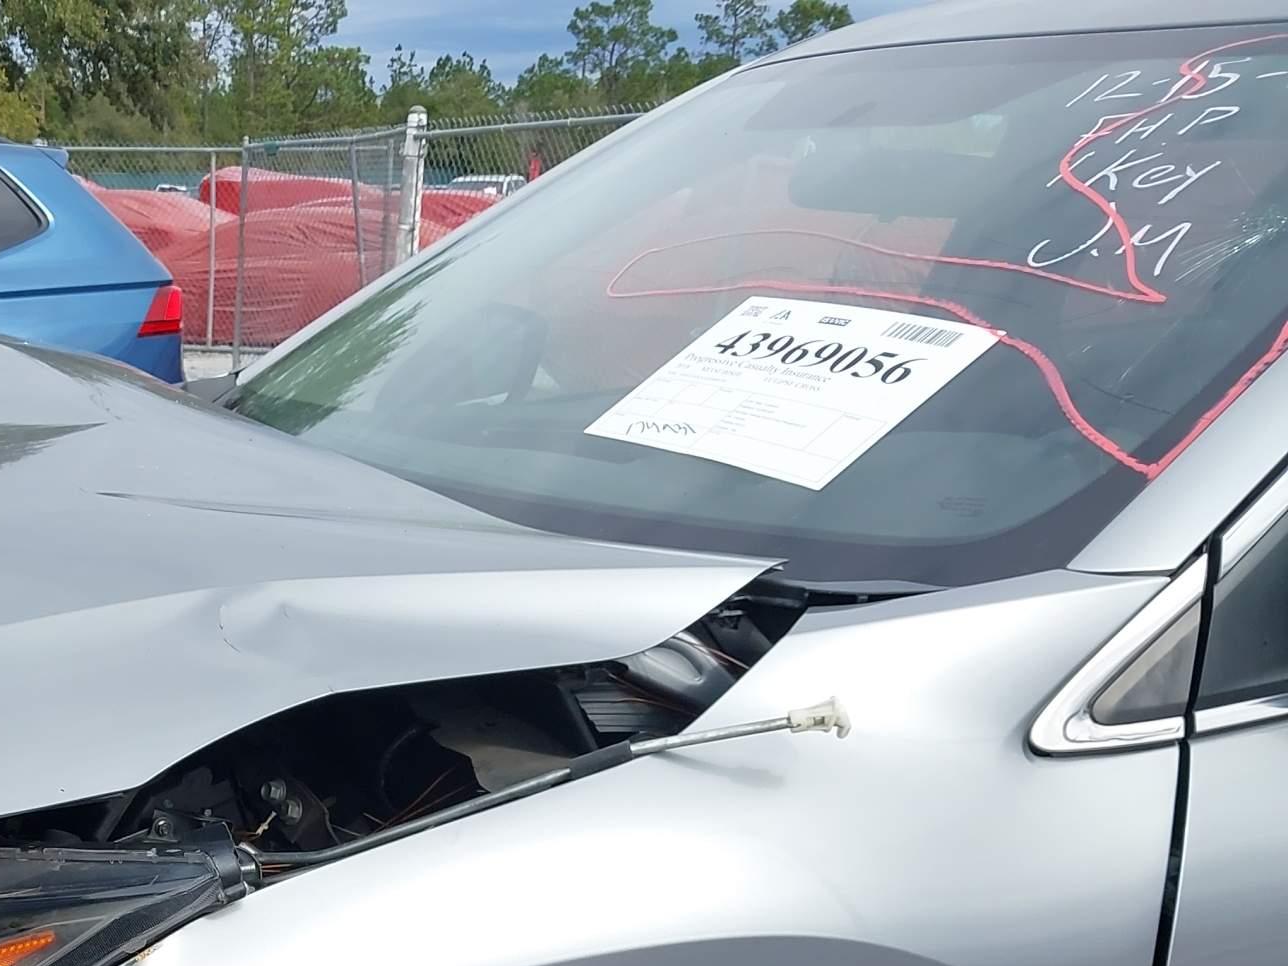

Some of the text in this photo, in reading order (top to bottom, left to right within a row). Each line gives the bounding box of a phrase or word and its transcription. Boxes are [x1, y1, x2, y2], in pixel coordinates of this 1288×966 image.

[1084, 149, 1222, 204] Key
[714, 330, 928, 385] 43969056
[737, 360, 781, 376] Casualty
[781, 367, 832, 383] Insurance
